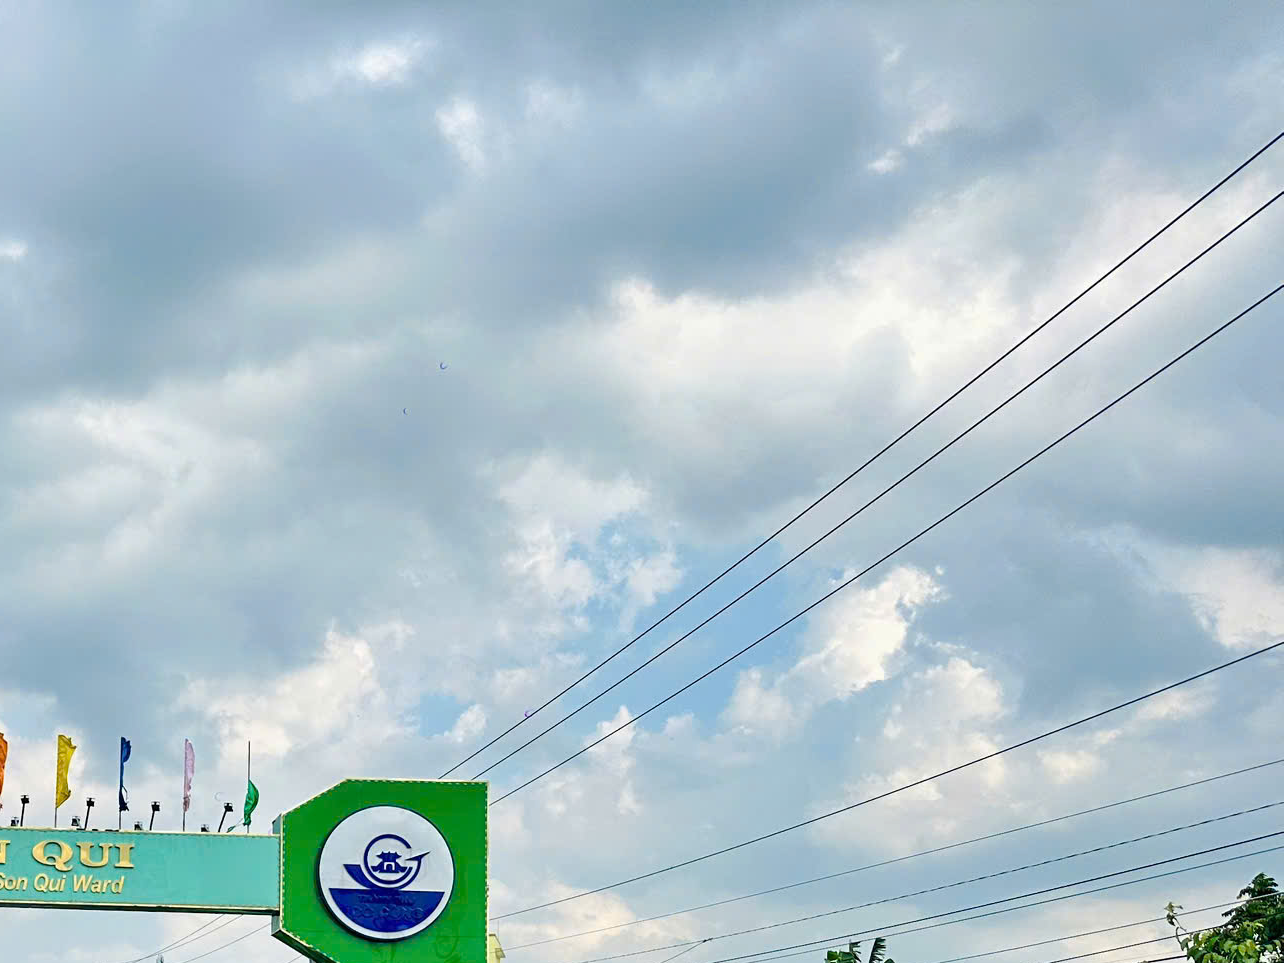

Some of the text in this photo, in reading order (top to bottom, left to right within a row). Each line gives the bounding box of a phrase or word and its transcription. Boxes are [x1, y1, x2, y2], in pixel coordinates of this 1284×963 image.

[32, 839, 135, 872] QUI
[33, 873, 67, 893] Qui
[73, 874, 125, 894] Ward
